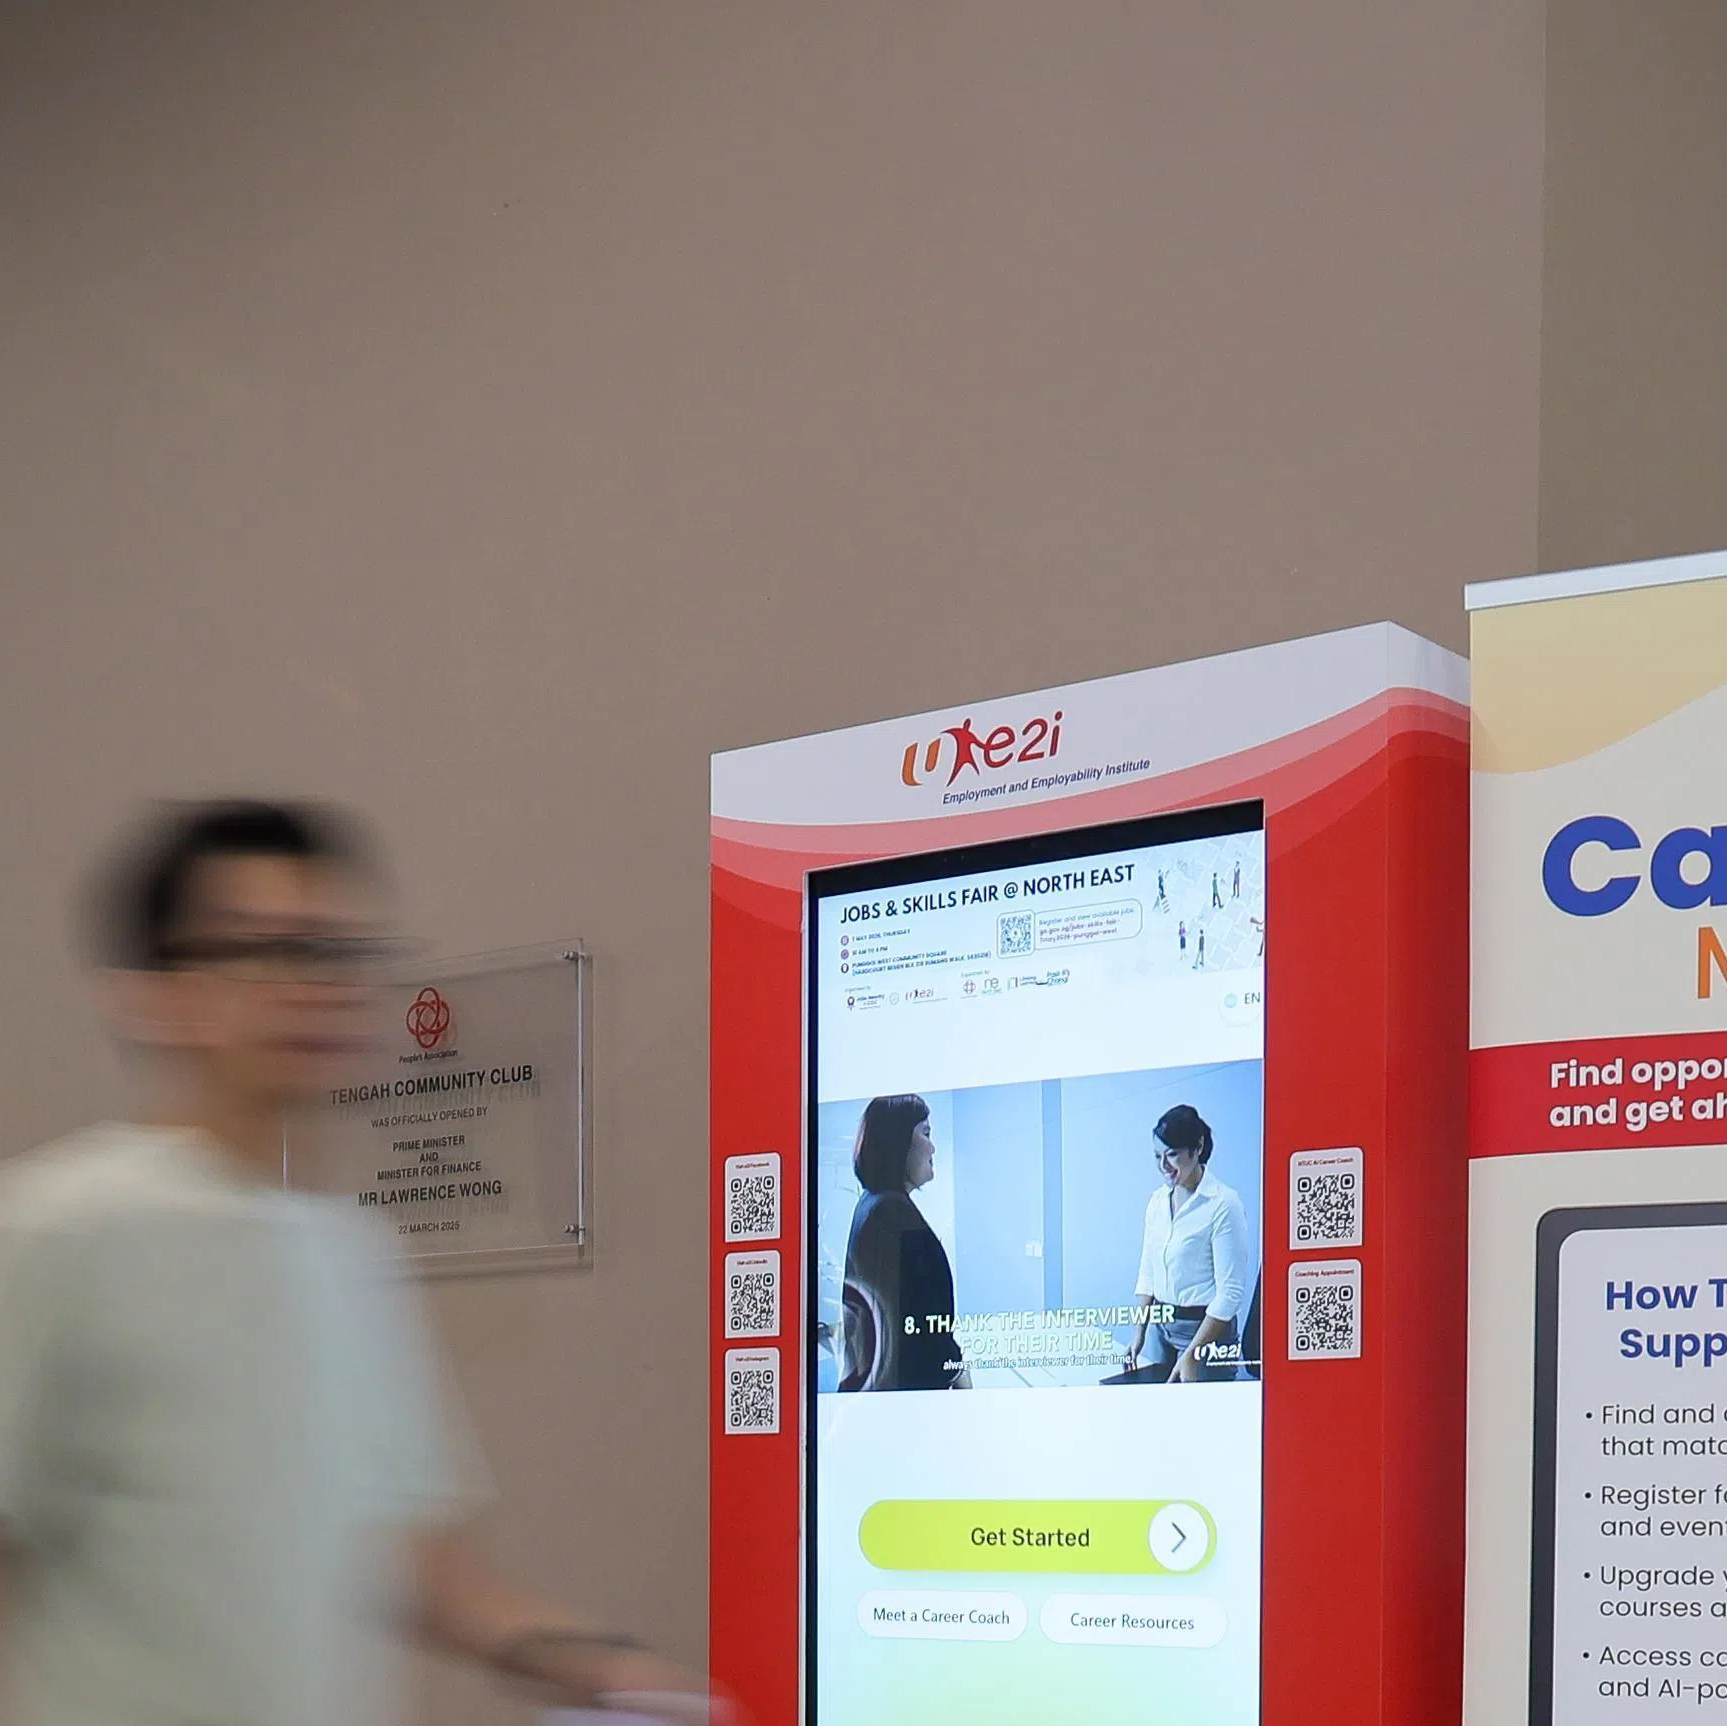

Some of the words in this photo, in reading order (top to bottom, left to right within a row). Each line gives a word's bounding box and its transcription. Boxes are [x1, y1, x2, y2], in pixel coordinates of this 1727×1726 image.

[943, 779, 1006, 804] Employment
[1009, 780, 1028, 792] and
[1031, 768, 1103, 791] Employability
[1106, 760, 1150, 775] Institute
[841, 903, 880, 923] JOBS
[886, 900, 898, 916] &
[903, 891, 957, 914] SKILLS
[962, 885, 998, 905] FAIR
[1004, 882, 1018, 898] @
[1024, 871, 1084, 896] NORTH
[1091, 864, 1134, 886] EAST
[1245, 992, 1260, 1004] EN
[1552, 1059, 1624, 1088] Find
[331, 1083, 390, 1104] TENGAH
[394, 1070, 486, 1097] COMMUNITY
[490, 1065, 533, 1085] CLUB
[371, 1117, 390, 1128] WAS
[391, 1112, 438, 1126] OFFICIALLY
[440, 1108, 474, 1121] OPENED
[477, 1106, 488, 1116] BY
[1550, 1098, 1618, 1126] and
[1626, 1096, 1685, 1131] get
[393, 1140, 420, 1152] PRIME
[422, 1135, 465, 1149] MINISTER
[419, 1152, 439, 1163] AND
[377, 1166, 419, 1180] MINISTER
[421, 1164, 439, 1176] FOR
[442, 1161, 481, 1175] FINANCE
[358, 1191, 377, 1206] MR
[381, 1185, 456, 1205] LAWRENCE
[459, 1180, 502, 1197] WONG
[398, 1224, 407, 1234] 22
[409, 1222, 439, 1233] MARCH
[441, 1220, 460, 1231] 2025
[1320, 1269, 1355, 1277] Appointment
[1607, 1281, 1698, 1310] How
[905, 1316, 920, 1334] 8.
[926, 1313, 994, 1333] THANK
[996, 1308, 1038, 1331] THE
[1040, 1304, 1175, 1329] INTERVIEWER
[960, 1334, 1000, 1355] FOR
[1004, 1335, 1059, 1353] THEIR
[1066, 1328, 1116, 1351] TIME
[1603, 1404, 1654, 1424] Find
[1664, 1404, 1714, 1423] and
[1602, 1436, 1654, 1455] that
[1602, 1485, 1706, 1511] Register
[1601, 1517, 1651, 1536] and
[971, 1528, 1006, 1545] Get
[1013, 1528, 1089, 1547] Started
[1601, 1566, 1714, 1591] Upgrade
[874, 1608, 905, 1621] Meet
[911, 1612, 917, 1621] a
[922, 1609, 964, 1623] Career
[969, 1610, 1009, 1624] Coach
[1600, 1601, 1701, 1617] courses
[1071, 1613, 1116, 1627] Career
[1122, 1614, 1194, 1629] Resources
[1600, 1646, 1691, 1666] Access
[1599, 1678, 1648, 1697] and
